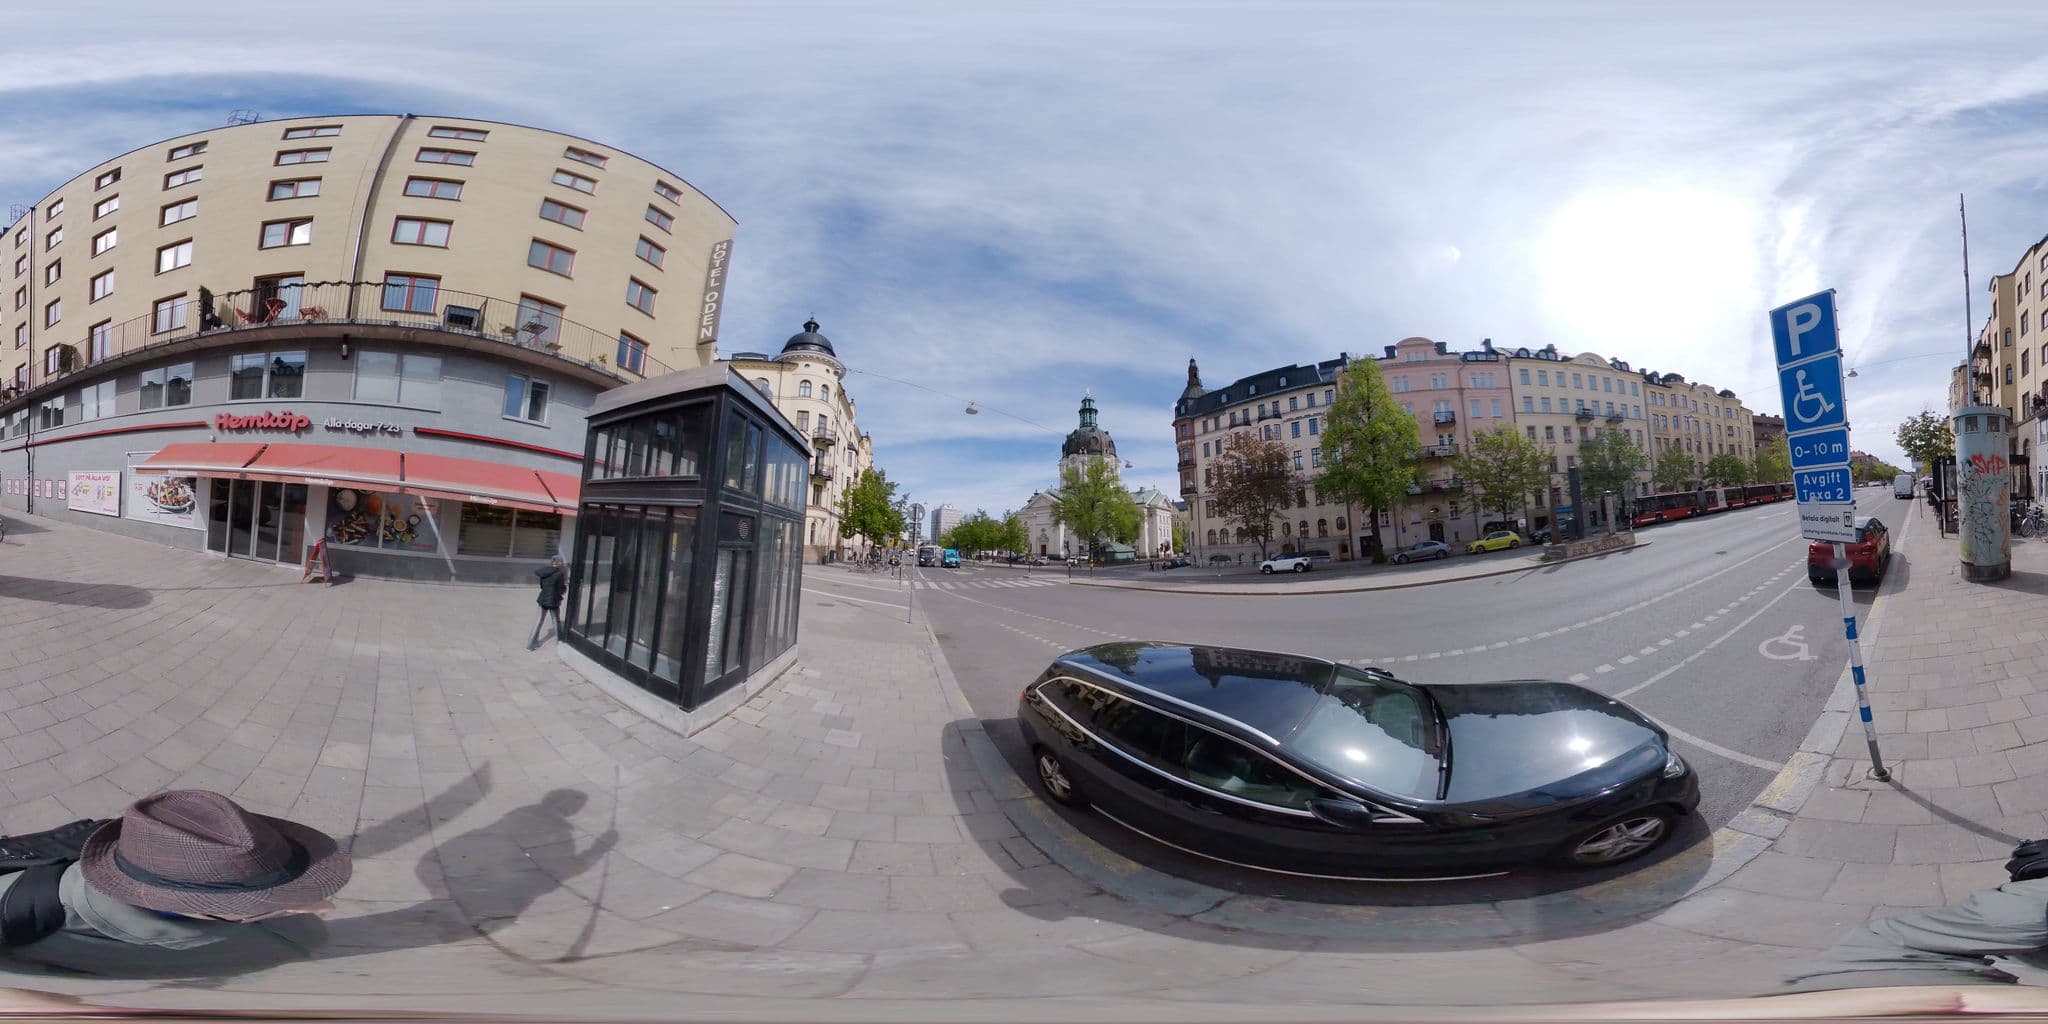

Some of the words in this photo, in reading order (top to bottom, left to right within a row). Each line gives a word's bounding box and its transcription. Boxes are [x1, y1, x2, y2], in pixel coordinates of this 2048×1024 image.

[710, 242, 727, 287] HOTEL
[700, 292, 719, 339] ODEN
[1786, 303, 1822, 357] P
[215, 410, 309, 432] Hemköp
[323, 417, 342, 428] Alla
[344, 419, 374, 432] dagar
[376, 422, 400, 433] 7-23
[1832, 442, 1843, 454] m
[1803, 471, 1841, 487] Avgift
[1836, 487, 1844, 500] 2
